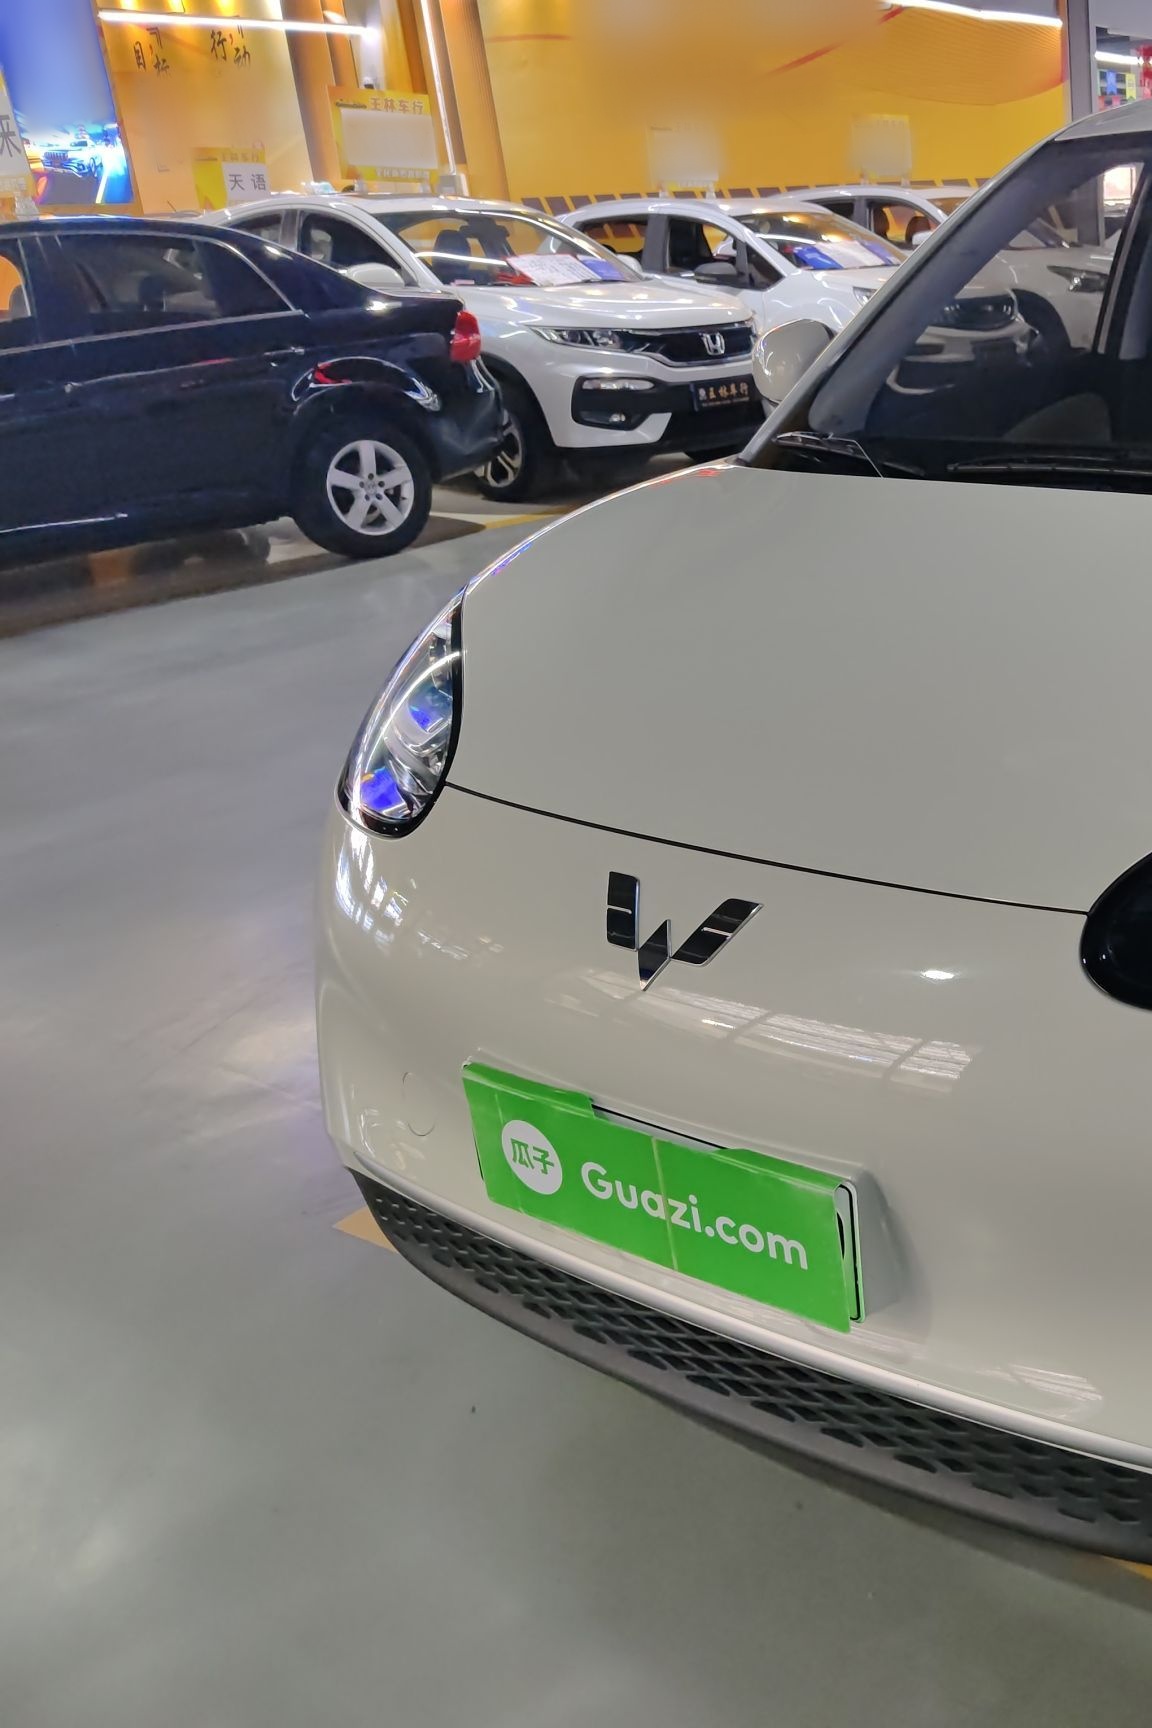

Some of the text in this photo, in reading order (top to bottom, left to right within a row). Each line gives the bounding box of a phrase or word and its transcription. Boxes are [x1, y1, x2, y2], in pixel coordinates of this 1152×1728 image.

[228, 174, 267, 191] 天语
[510, 1136, 555, 1175] 瓜子
[580, 1161, 808, 1270] Guazi.com
